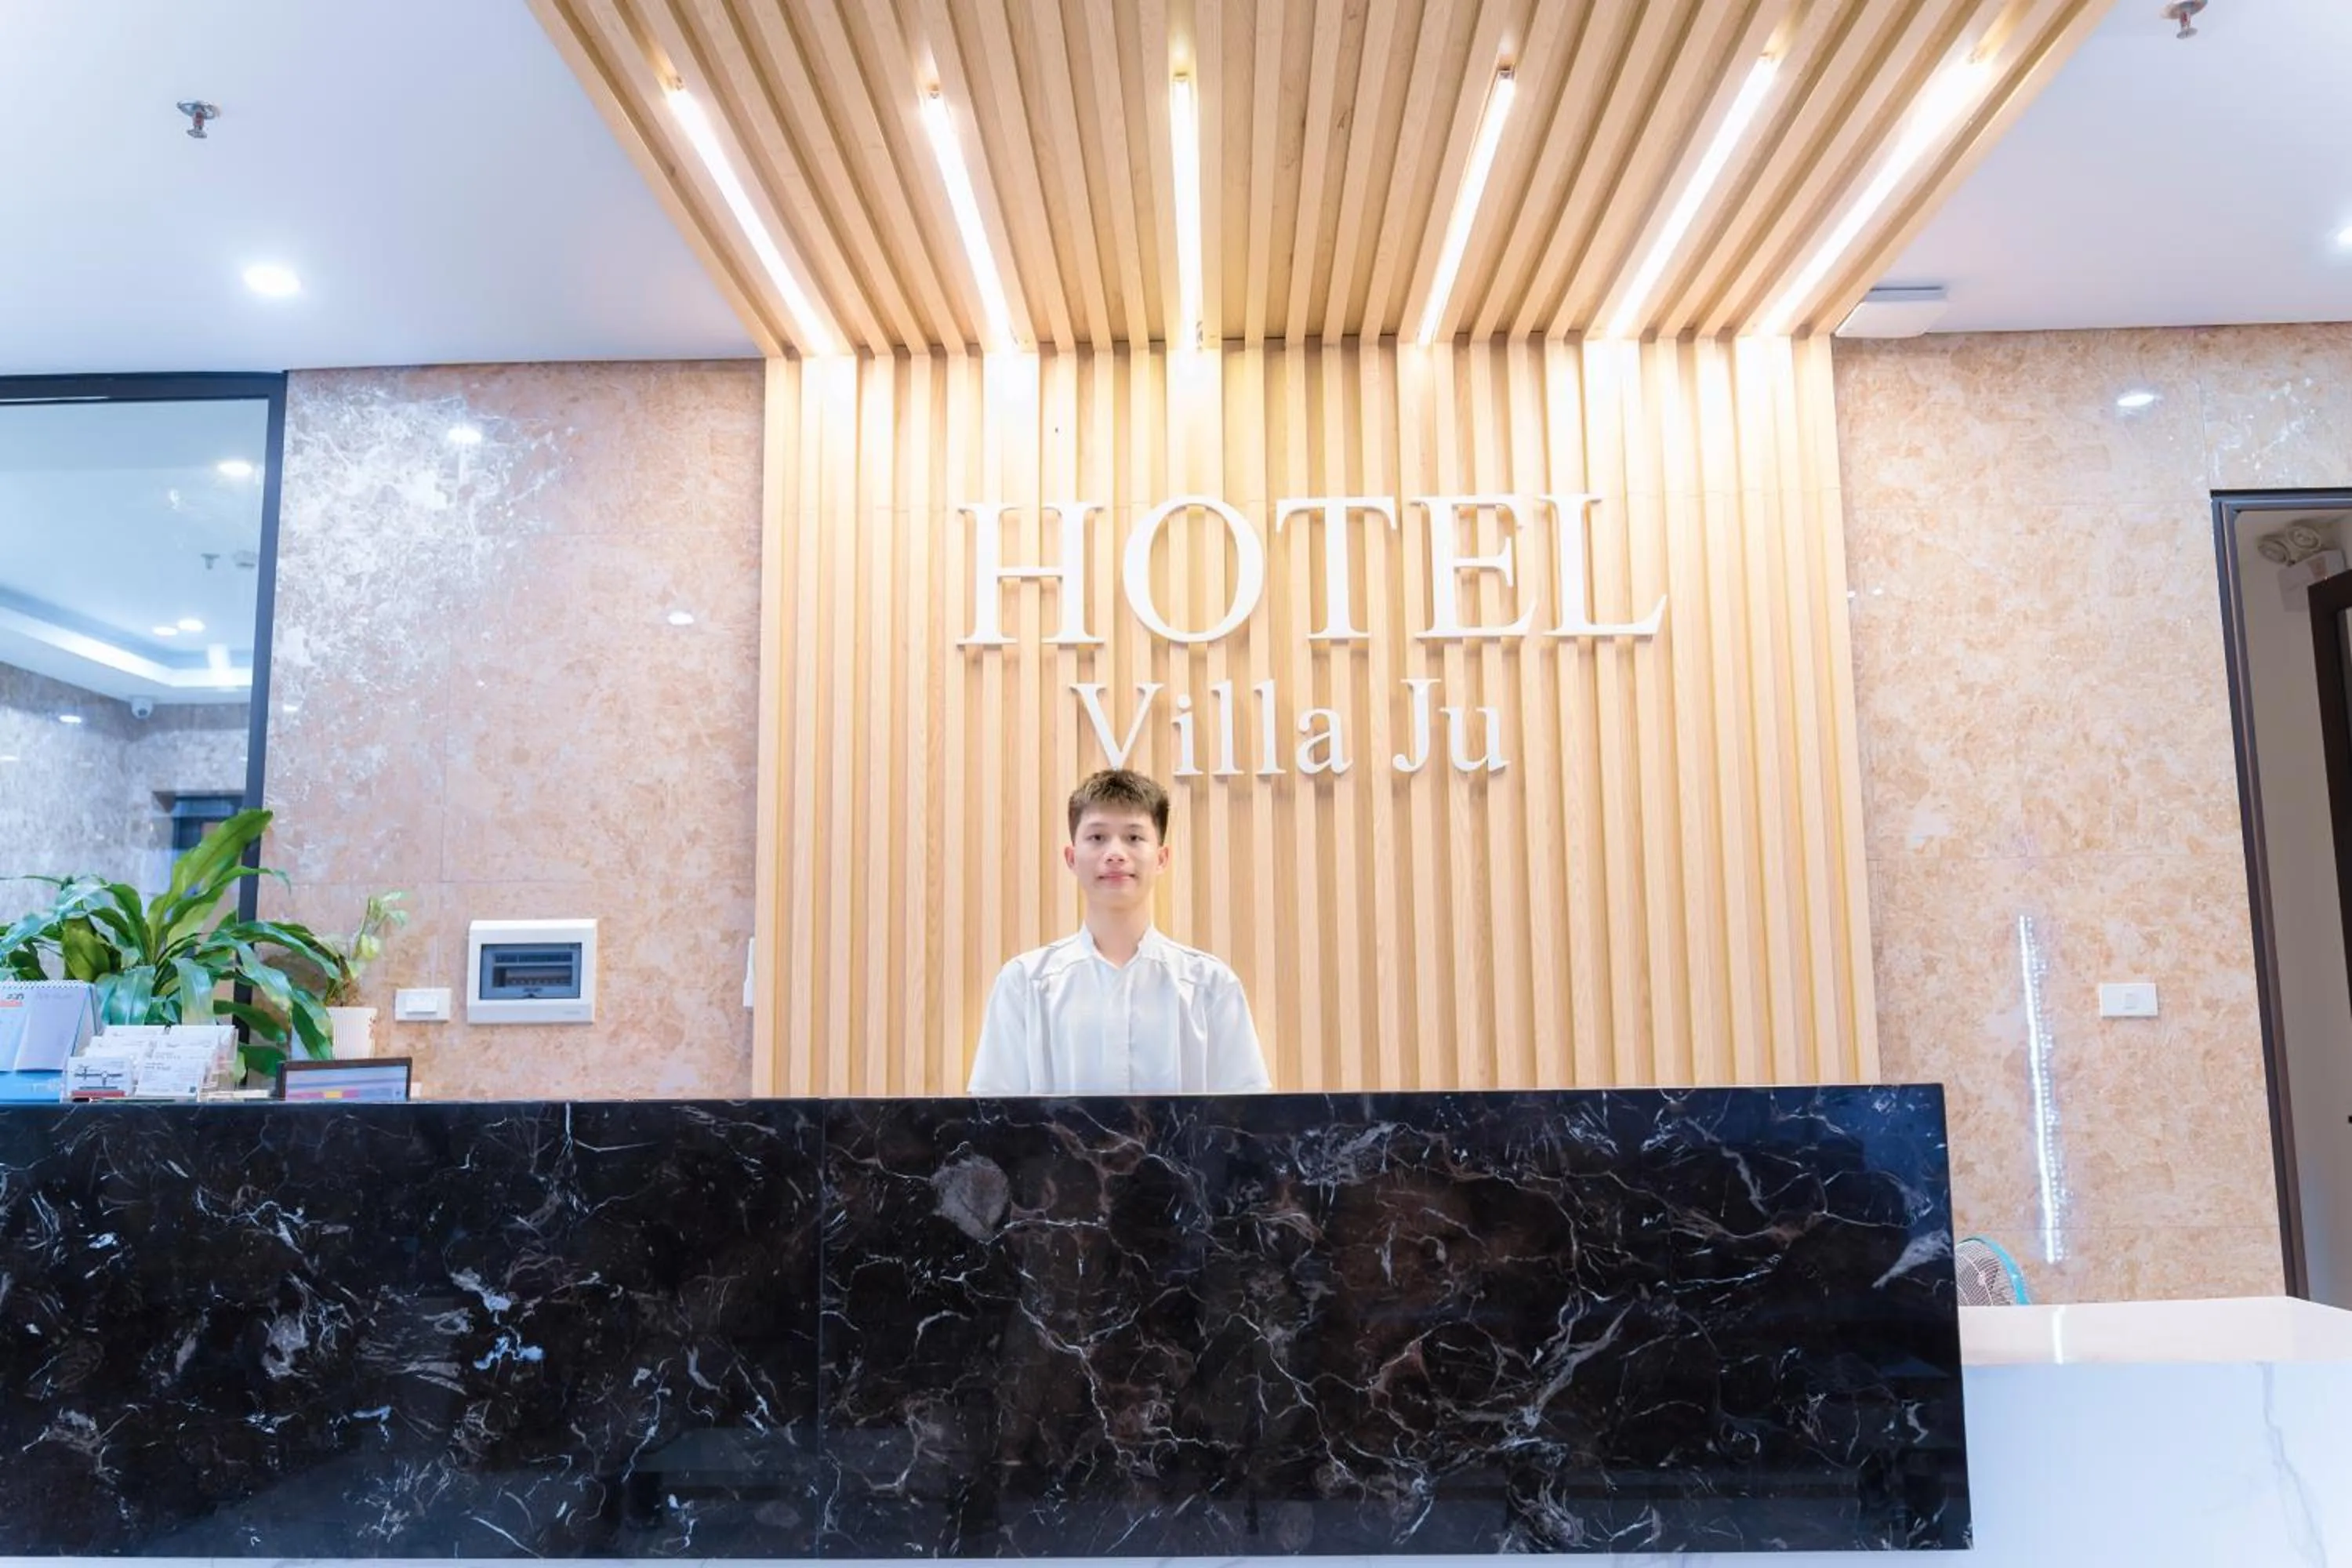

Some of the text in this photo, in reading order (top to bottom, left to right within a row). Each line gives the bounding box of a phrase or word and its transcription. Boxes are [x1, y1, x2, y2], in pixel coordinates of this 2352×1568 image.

[956, 494, 1668, 646] HOTEL
[1069, 677, 1511, 775] Villa Ju
